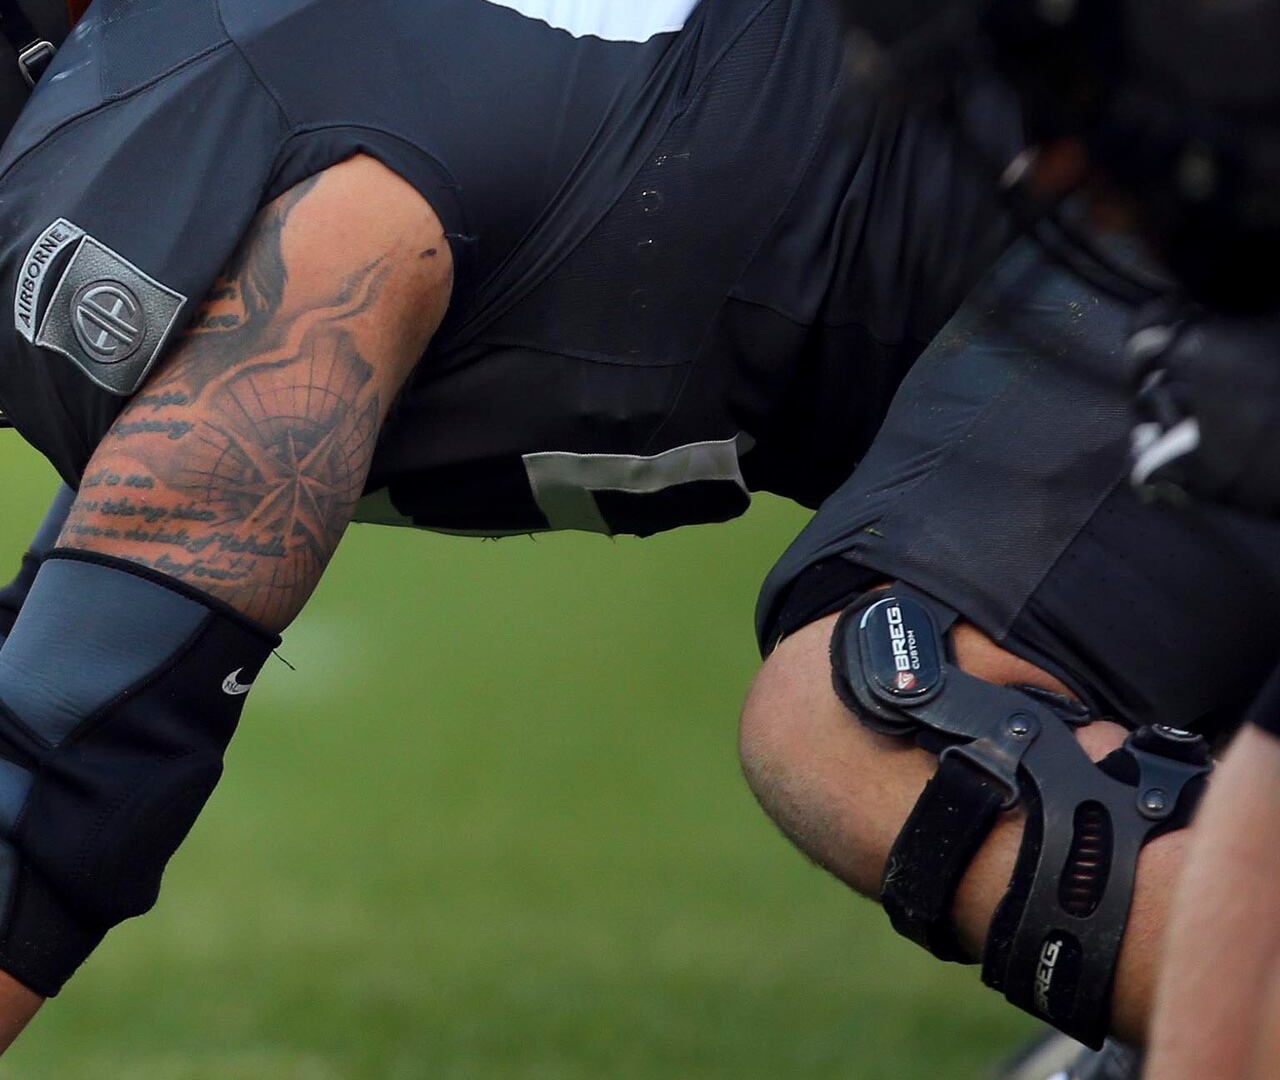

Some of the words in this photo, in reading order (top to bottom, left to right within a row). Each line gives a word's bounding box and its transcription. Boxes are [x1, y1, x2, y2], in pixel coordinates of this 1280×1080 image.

[16, 227, 70, 329] AIRBORNE
[886, 606, 911, 671] BREG
[906, 629, 921, 670] CUSTOM
